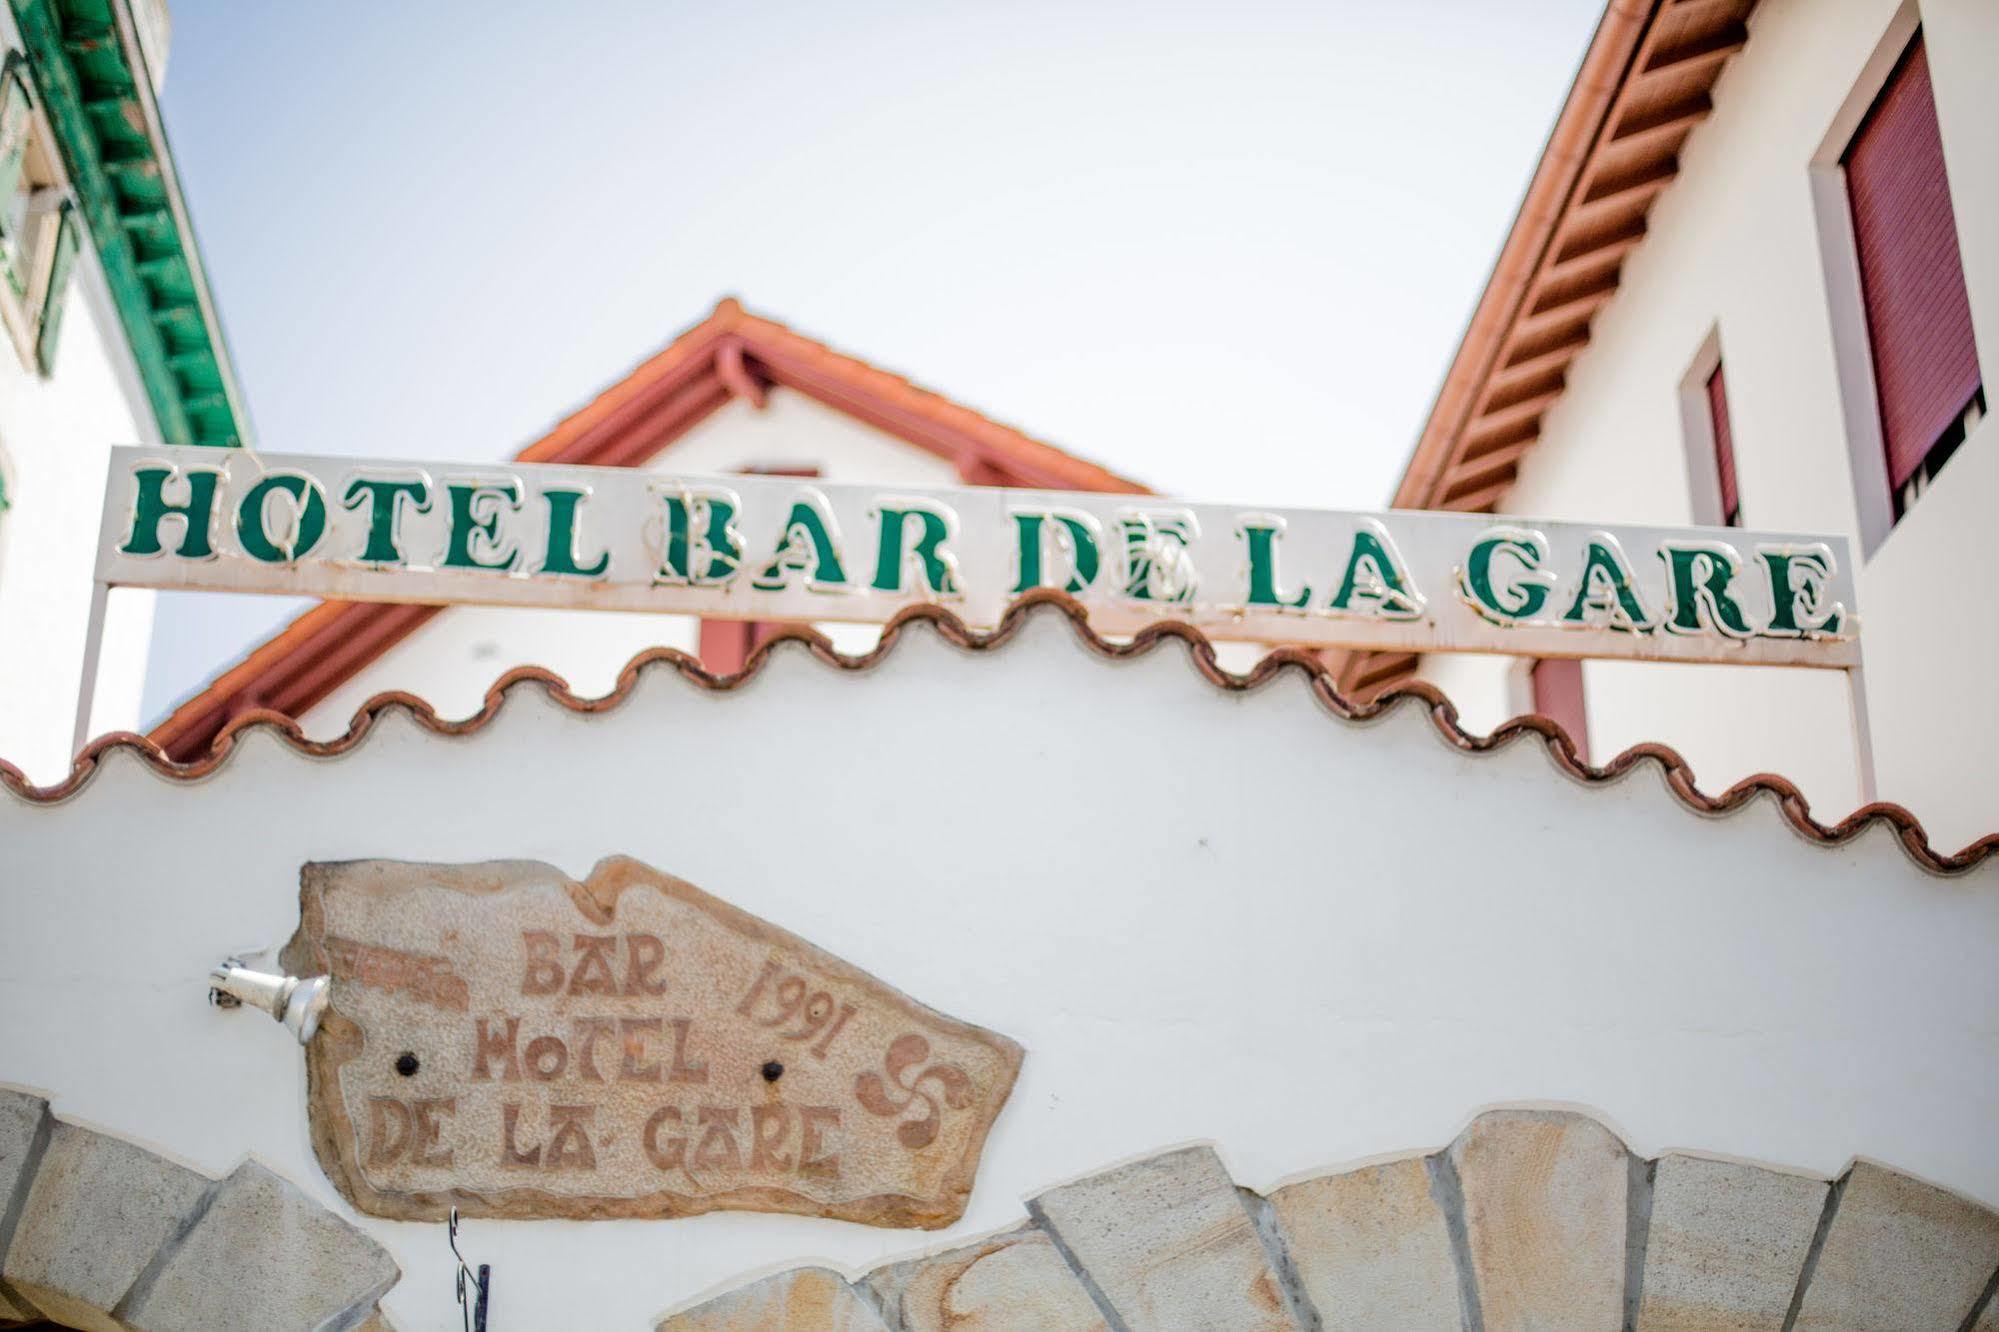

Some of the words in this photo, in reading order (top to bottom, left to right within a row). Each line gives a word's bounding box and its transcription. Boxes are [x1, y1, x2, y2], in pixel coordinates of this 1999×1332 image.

[115, 461, 610, 578] HOTEL
[650, 482, 963, 600] BAR
[1006, 503, 1202, 602] DE
[1236, 512, 1428, 620] LA
[1454, 523, 1850, 642] GARE
[521, 930, 670, 997] BAR
[735, 961, 855, 1060] 1991
[369, 1097, 456, 1168] DE
[504, 1104, 597, 1171] LA
[642, 1104, 842, 1182] GARE
